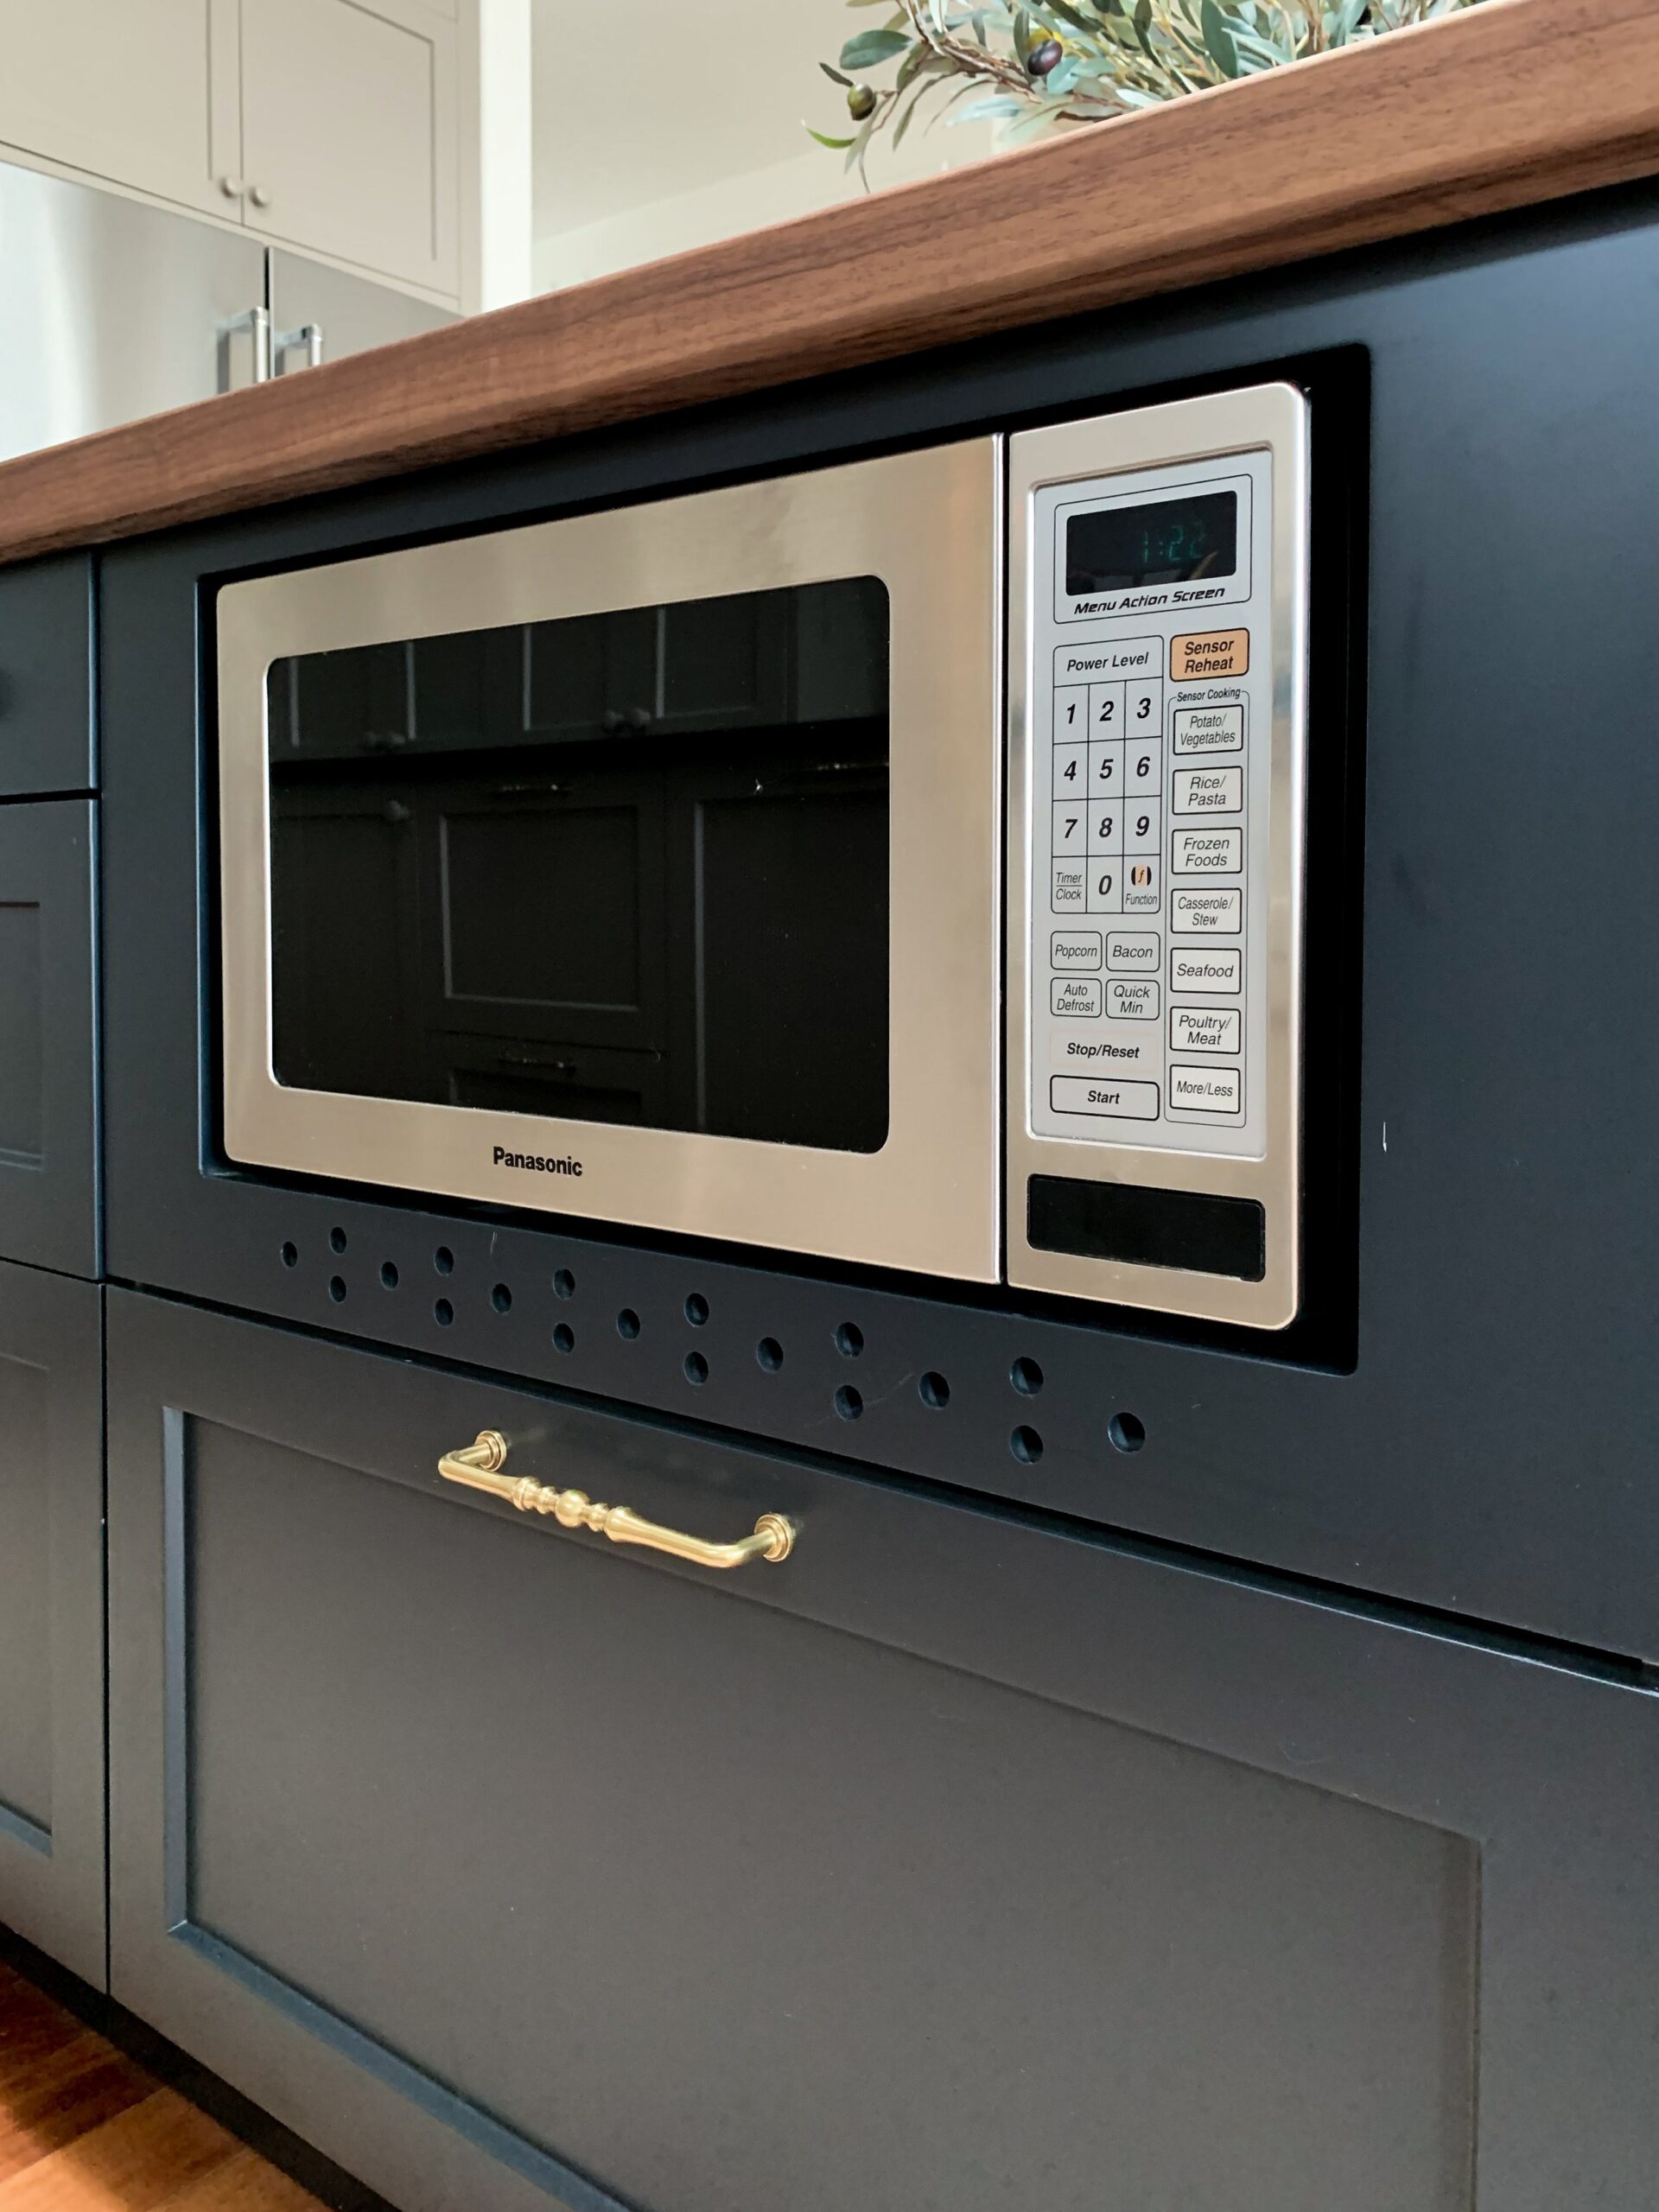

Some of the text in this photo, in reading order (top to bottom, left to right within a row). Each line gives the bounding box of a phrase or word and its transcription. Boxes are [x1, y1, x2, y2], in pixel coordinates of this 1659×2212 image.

[1141, 520, 1207, 563] 1:22
[1074, 588, 1225, 614] Menu Action Screen
[1184, 639, 1235, 656] Sensor
[1066, 652, 1149, 672] Power Level
[1184, 656, 1234, 673] Reheat
[1176, 688, 1241, 702] Sensor Cooking
[1065, 697, 1151, 724] 1 2 3
[1189, 713, 1227, 729] Potato/
[1180, 731, 1236, 748] Vegetables
[1064, 756, 1151, 781] 4 5 6
[1190, 775, 1227, 790] Rice/
[1188, 792, 1227, 806] Pasta
[1064, 816, 1150, 839] 7 8 9
[1183, 836, 1230, 850] Frozen
[1185, 853, 1228, 867] Foods
[1055, 872, 1082, 884] Timer
[1098, 874, 1112, 895] 0
[1055, 888, 1082, 900] Clock
[1125, 893, 1158, 906] Function
[1178, 895, 1234, 910] Casserole/
[1192, 913, 1218, 926] Stew
[1054, 944, 1098, 959] Popcorn
[1112, 945, 1154, 958] Bacon
[1176, 963, 1234, 977] Seafood
[1064, 983, 1088, 996] Auto
[1113, 984, 1150, 998] Quick
[1056, 999, 1095, 1012] Defrost
[1120, 1001, 1143, 1014] Min
[1179, 1014, 1232, 1032] Poultry/
[1186, 1032, 1222, 1046] Meat
[1066, 1042, 1140, 1058] Stop/Reset
[1176, 1080, 1233, 1097] More/Less
[1087, 1090, 1120, 1104] Start
[493, 1146, 582, 1177] Panasonic
